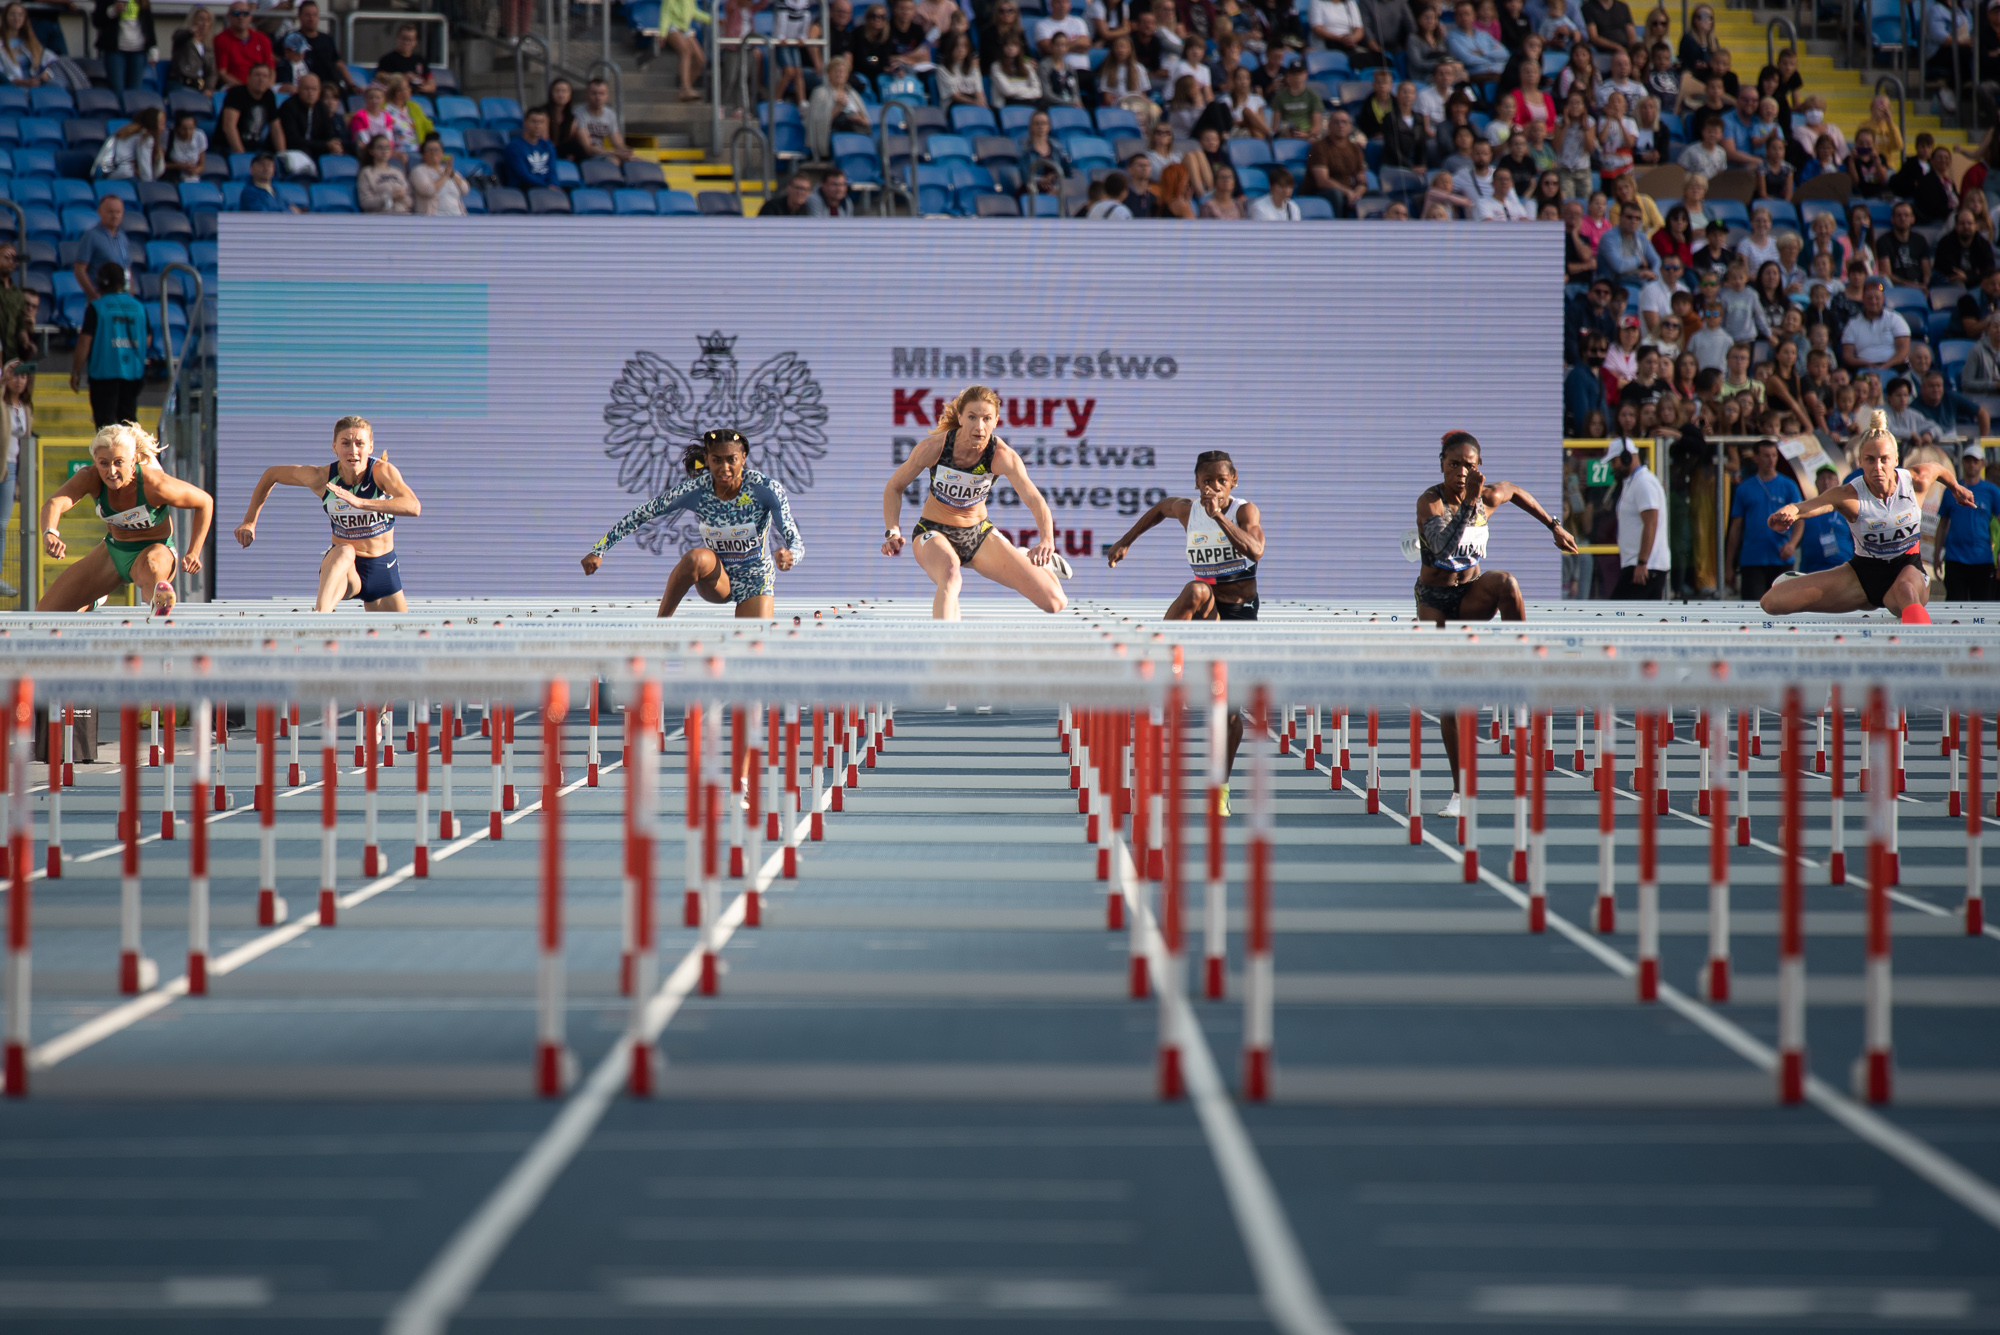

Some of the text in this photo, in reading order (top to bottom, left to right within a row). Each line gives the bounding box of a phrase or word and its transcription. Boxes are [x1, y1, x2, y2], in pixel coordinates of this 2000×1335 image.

[893, 347, 1178, 378] Ministerstwo
[1592, 461, 1608, 483] 27
[1863, 523, 1918, 543] CLAY
[704, 537, 757, 552] CLEMONS
